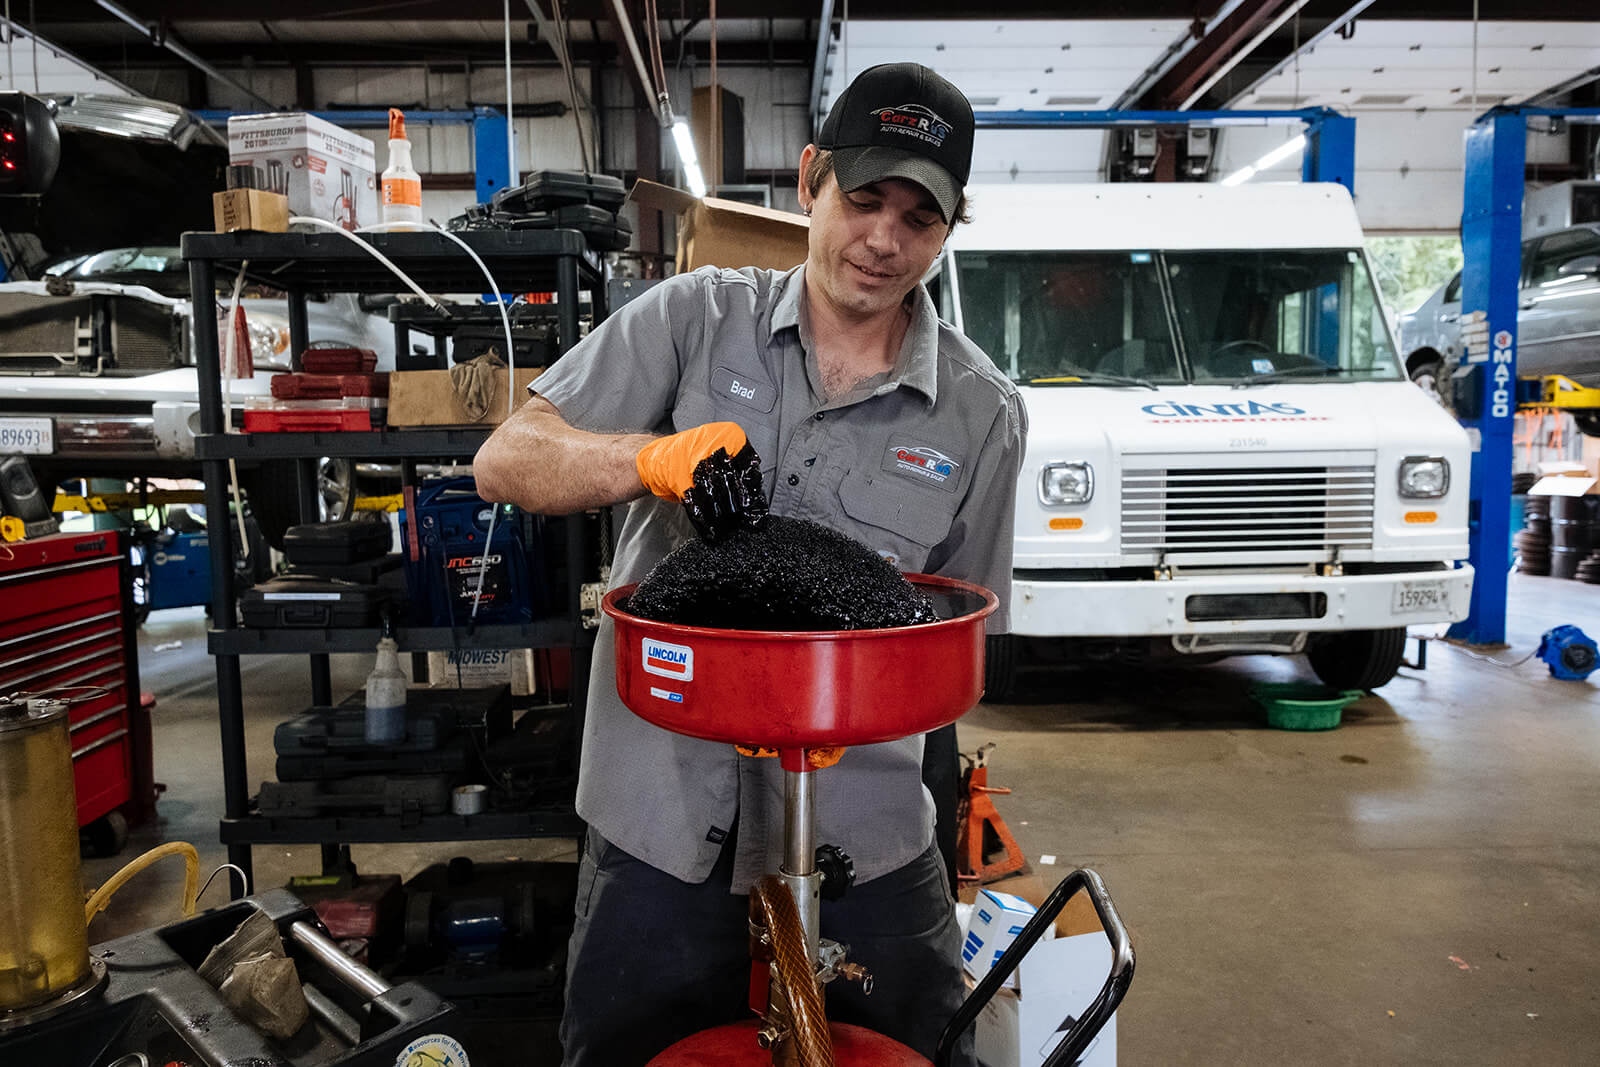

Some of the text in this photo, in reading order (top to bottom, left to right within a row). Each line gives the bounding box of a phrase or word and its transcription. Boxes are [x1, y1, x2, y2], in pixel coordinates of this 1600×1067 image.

[240, 127, 294, 140] PITTSBURGH
[730, 380, 756, 400] Brad
[1492, 349, 1512, 417] MATCO
[0, 429, 40, 446] 89693
[648, 646, 687, 663] LINCOLN
